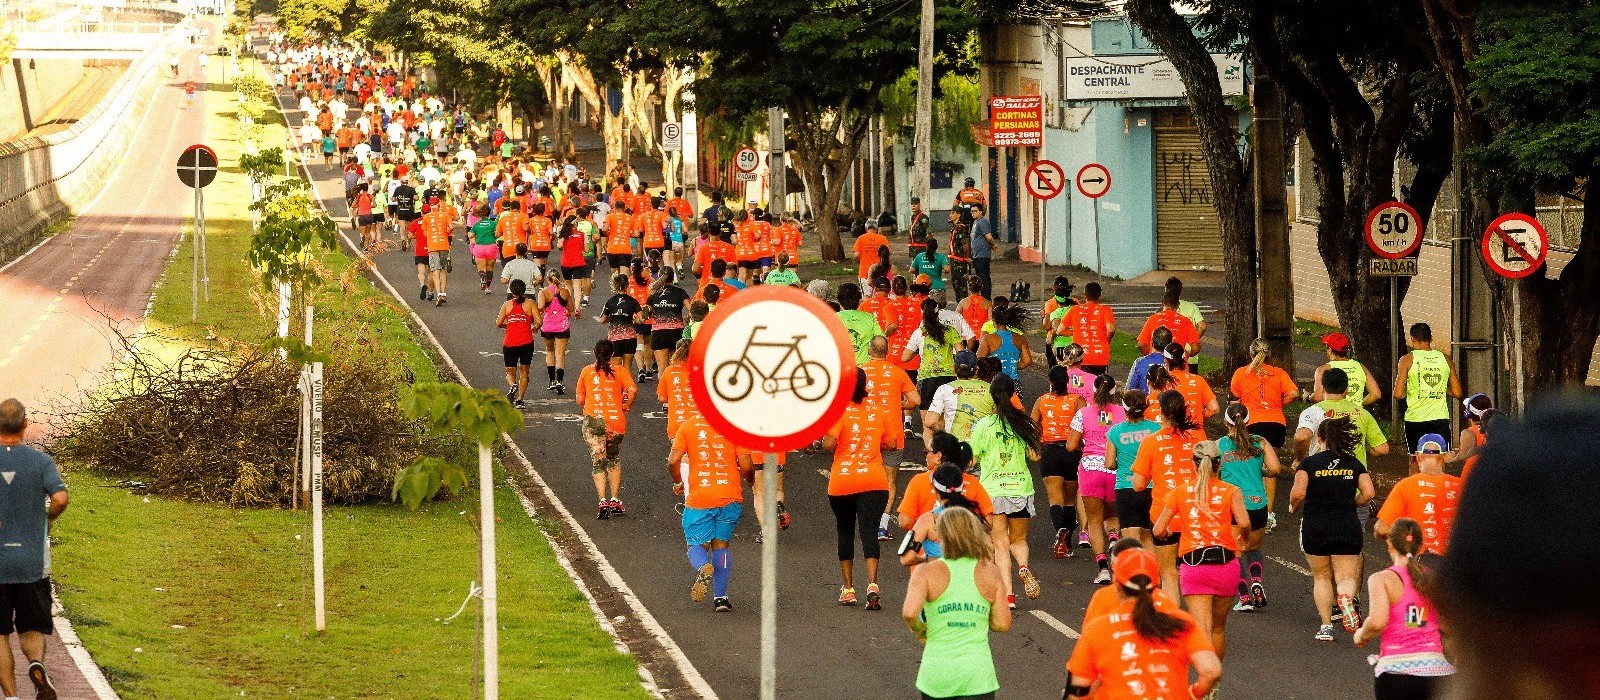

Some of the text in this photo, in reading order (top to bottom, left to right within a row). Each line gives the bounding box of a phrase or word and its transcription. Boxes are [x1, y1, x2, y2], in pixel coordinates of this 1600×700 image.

[1071, 65, 1144, 75] DESPACHANTE
[1084, 77, 1130, 87] CENTRAL
[996, 111, 1037, 120] CORTINAS
[994, 121, 1040, 130] PERSIANAS
[668, 126, 676, 136] E
[740, 152, 755, 162] 50
[1378, 212, 1409, 235] 50
[1373, 261, 1415, 274] RADAR
[313, 379, 322, 492] VIVEIRO SEMUSP PMM
[1315, 469, 1354, 477] eucorro
[937, 602, 962, 614] CORRA
[964, 602, 974, 611] NA
[1408, 605, 1425, 625] FV
